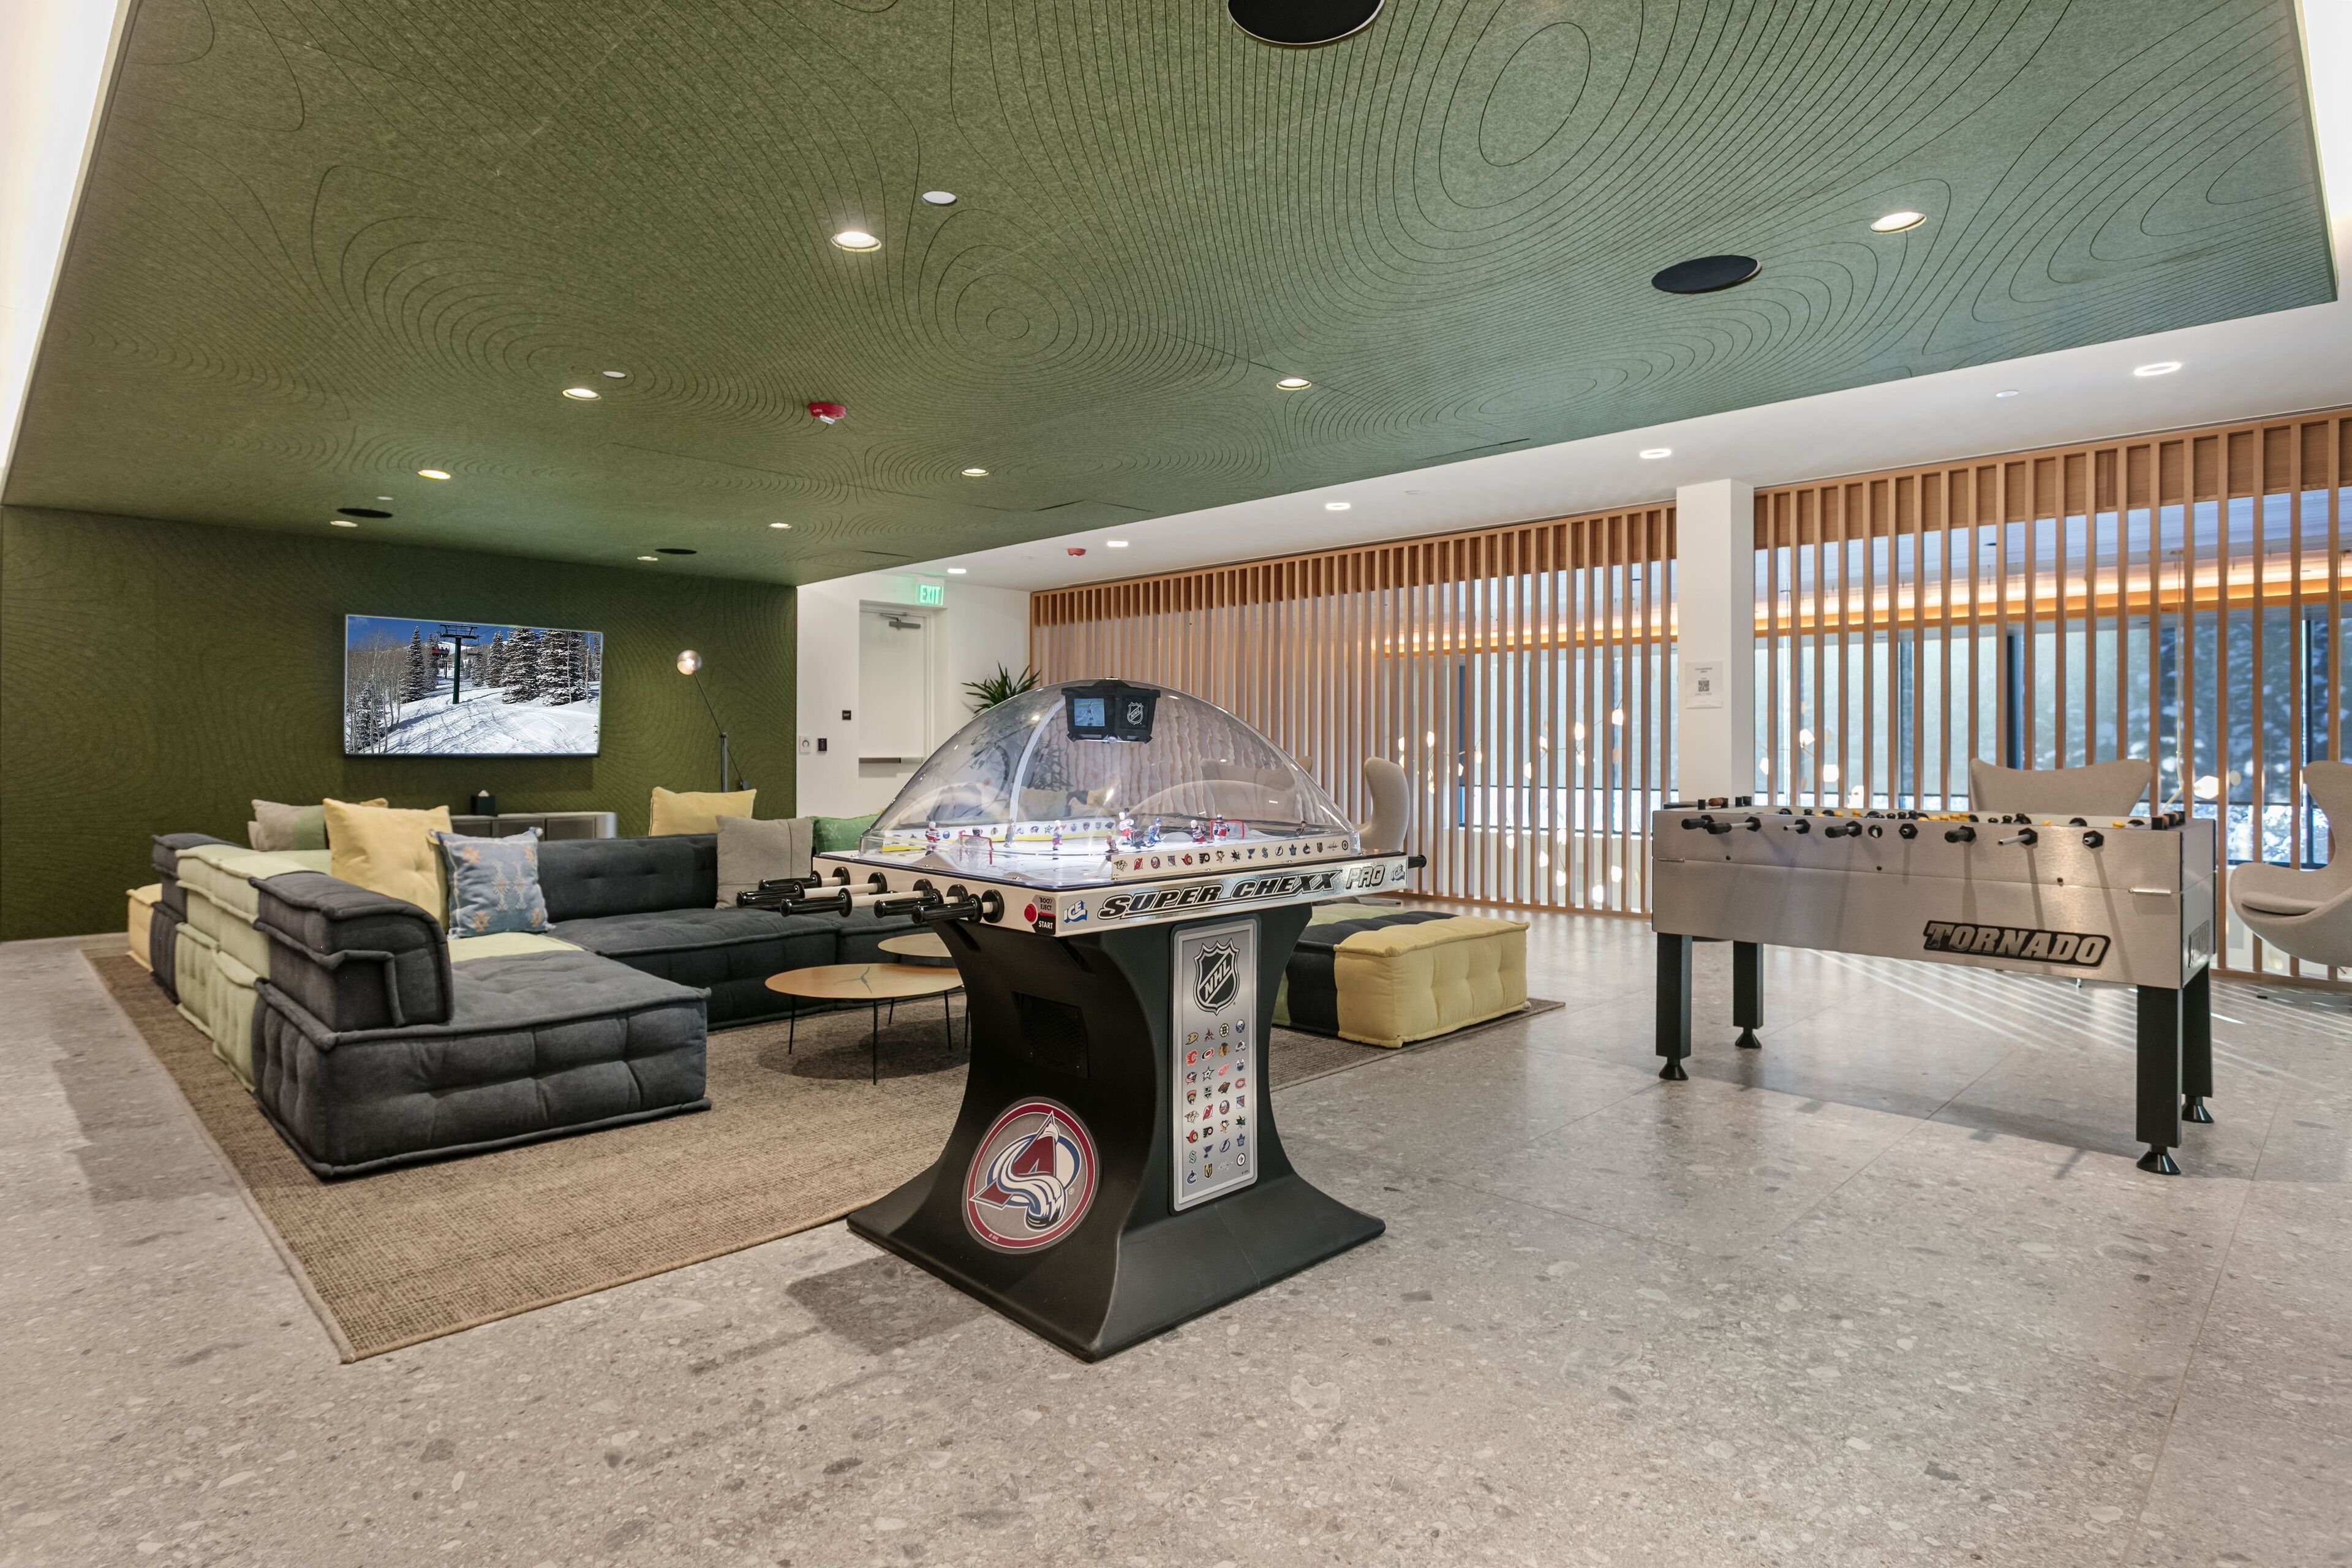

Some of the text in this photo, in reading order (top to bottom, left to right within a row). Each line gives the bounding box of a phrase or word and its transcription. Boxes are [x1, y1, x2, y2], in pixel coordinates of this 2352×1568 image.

[919, 584, 941, 605] EXIT
[1391, 864, 1405, 881] ICE
[1098, 864, 1385, 919] SUPER CHEXX PRO
[1063, 899, 1088, 923] ICE
[1038, 920, 1053, 929] START
[1926, 922, 2107, 964] TORNADO
[1204, 959, 1231, 1000] NHL
